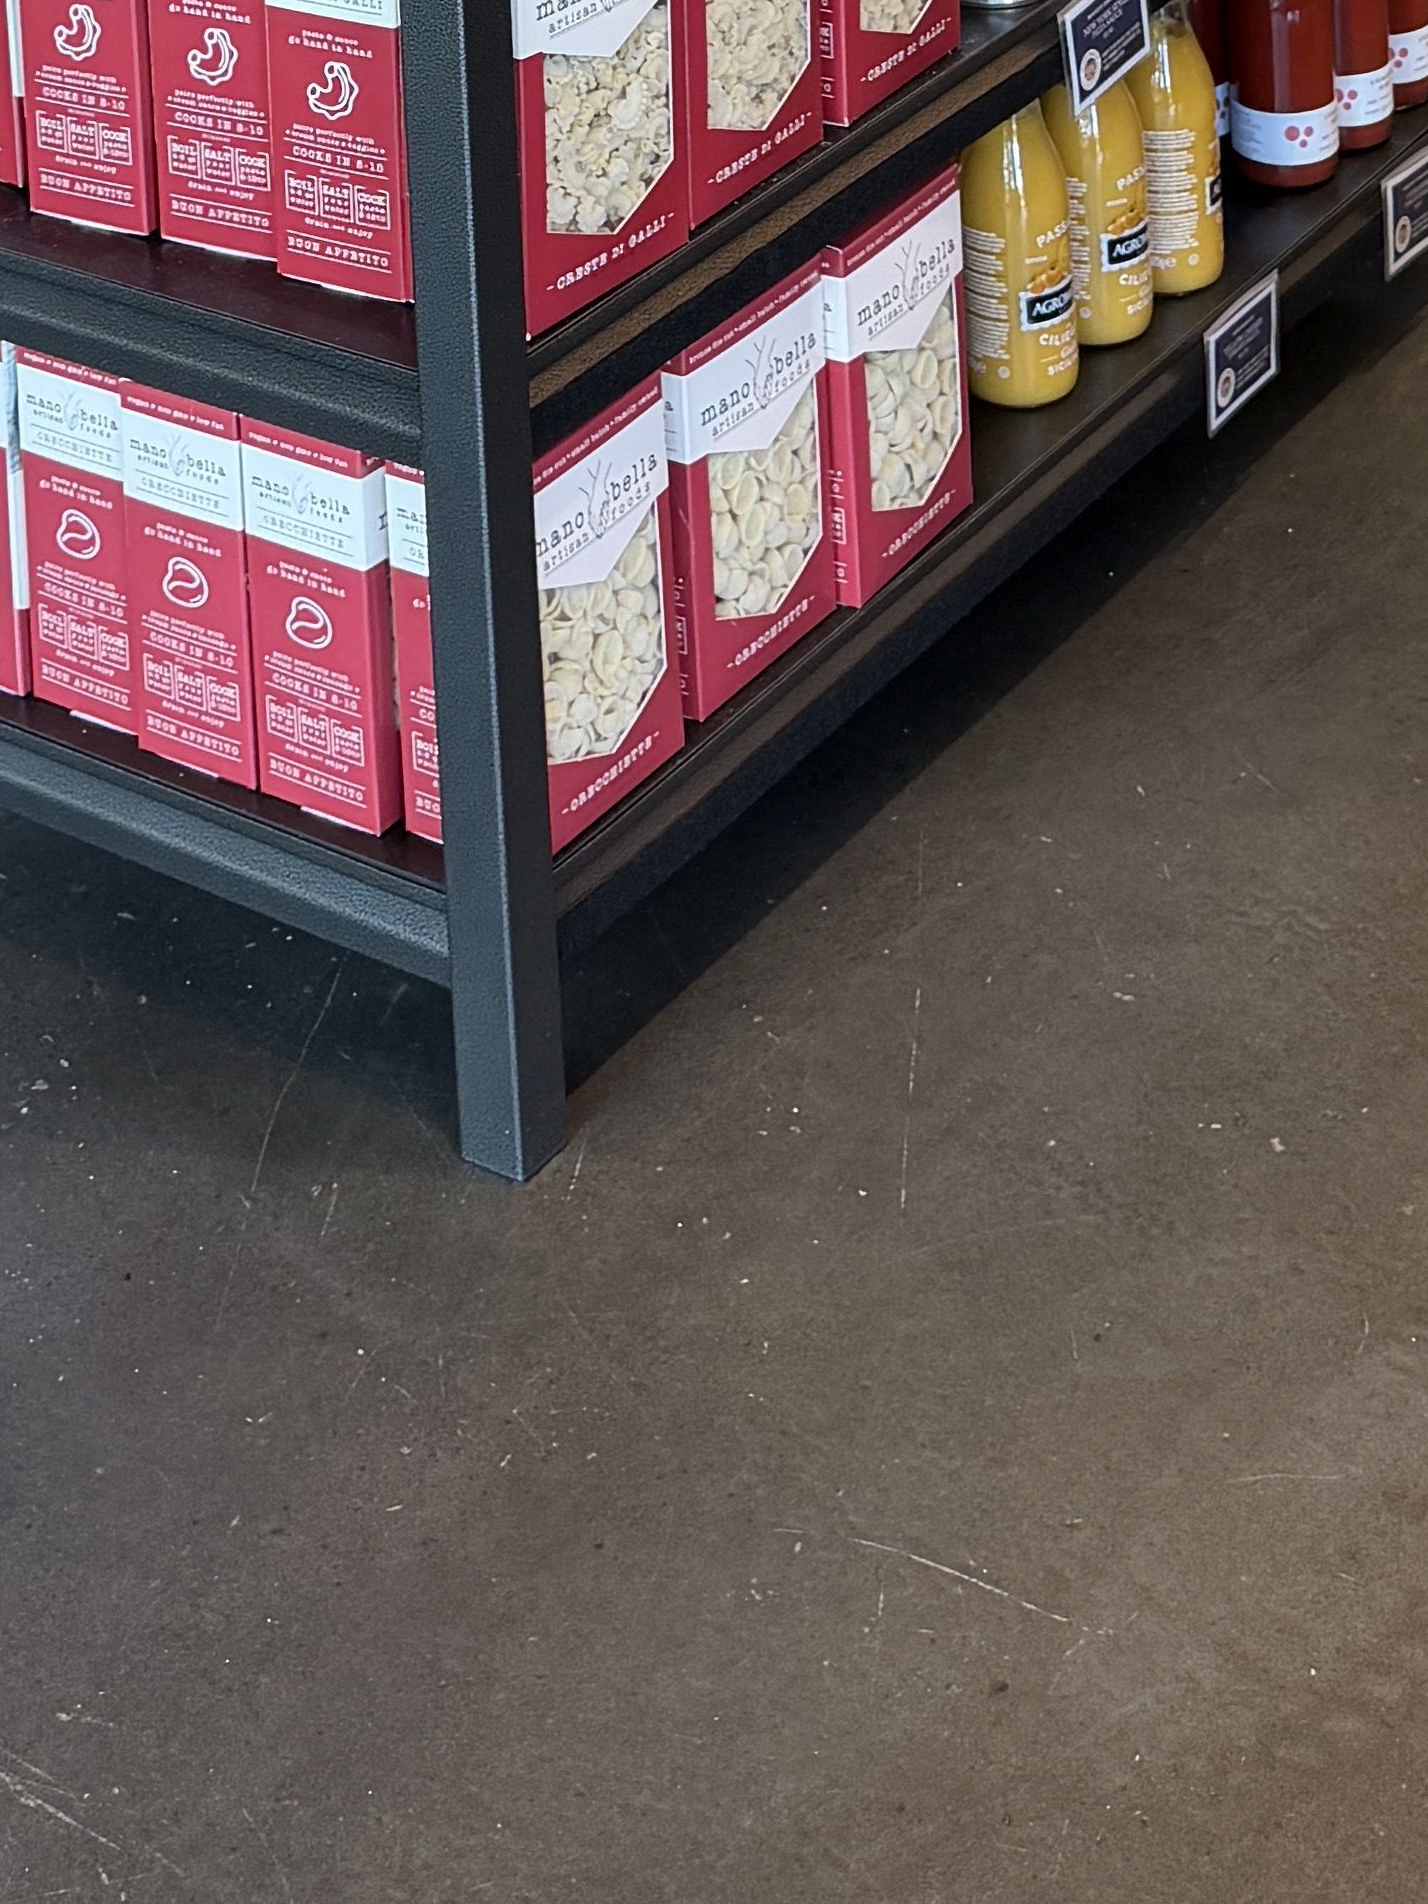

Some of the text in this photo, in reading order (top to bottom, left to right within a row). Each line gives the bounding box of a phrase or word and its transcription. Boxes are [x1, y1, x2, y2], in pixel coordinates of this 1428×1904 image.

[548, 2, 597, 35] artisan
[907, 40, 919, 60] DI
[761, 138, 773, 155] DI
[611, 242, 624, 261] DI
[858, 238, 956, 327] mano bella
[701, 329, 816, 426] mano bella
[130, 436, 226, 478] mano bella
[609, 453, 658, 497] bella
[544, 482, 651, 571] artisan foods
